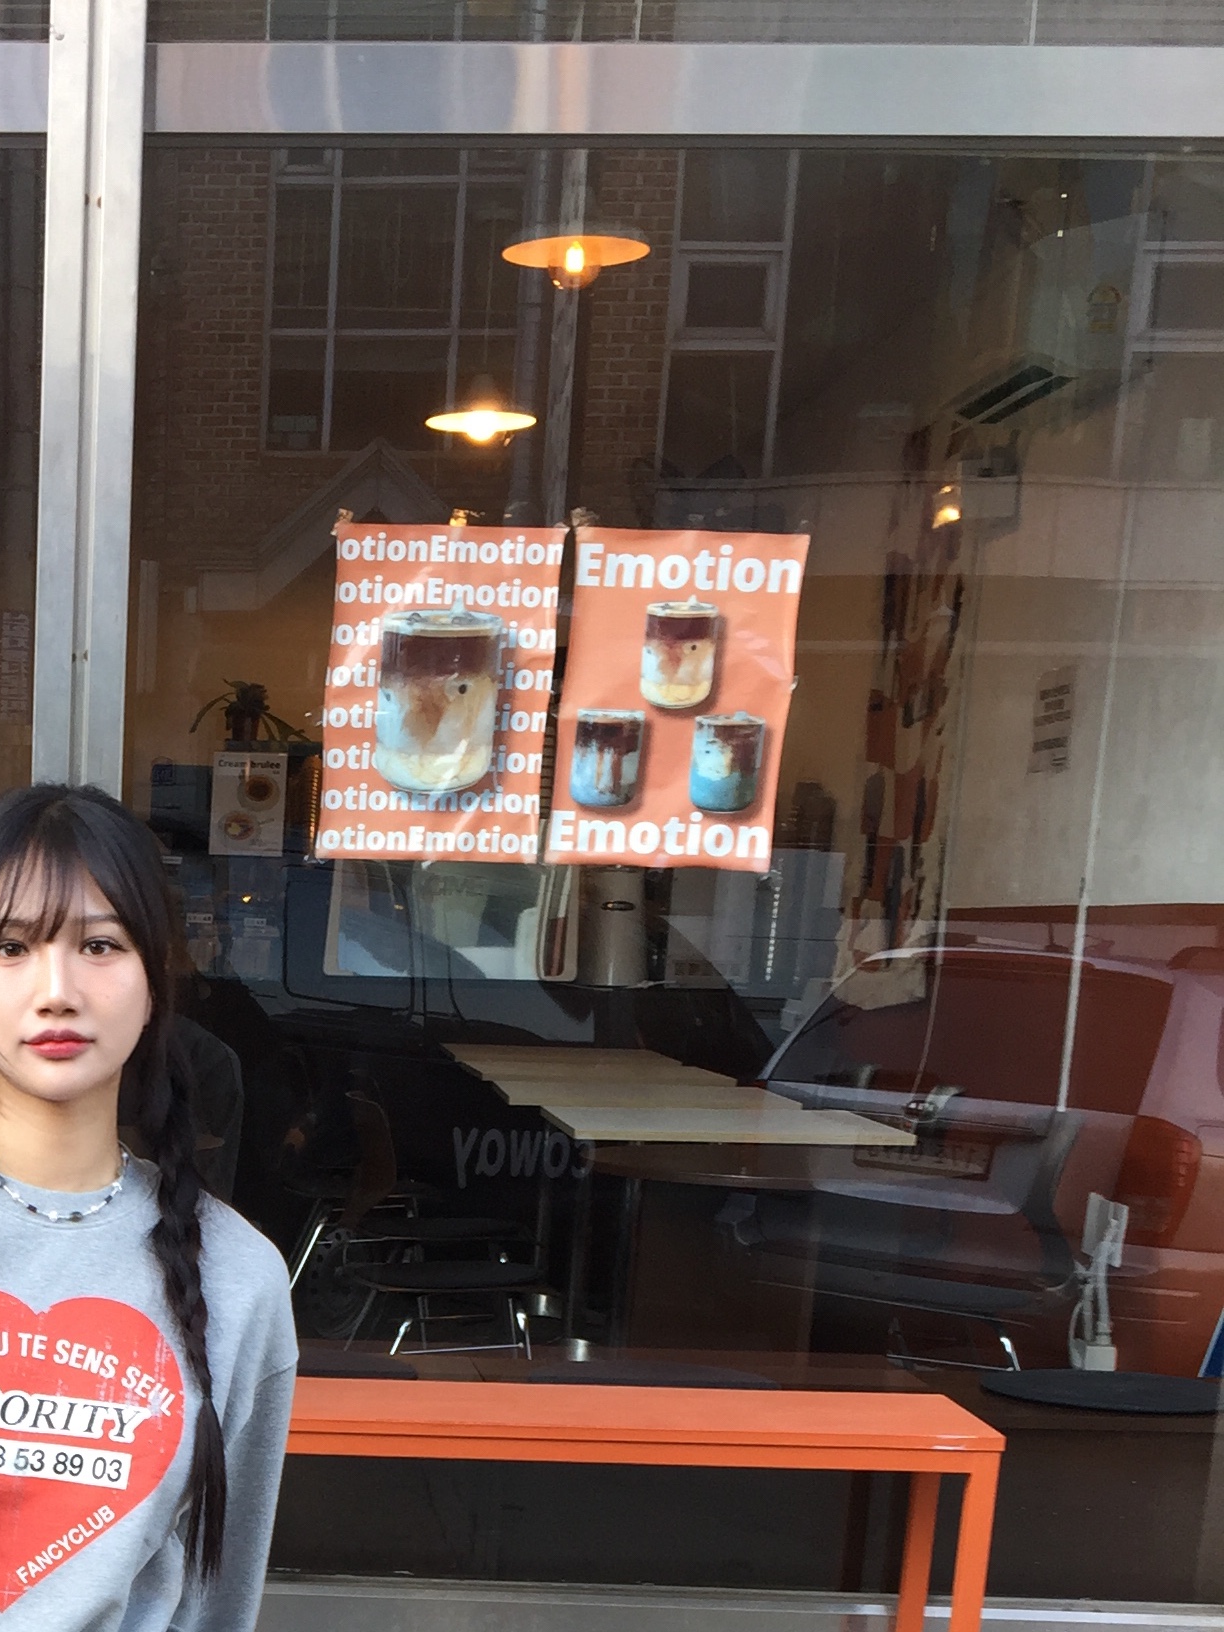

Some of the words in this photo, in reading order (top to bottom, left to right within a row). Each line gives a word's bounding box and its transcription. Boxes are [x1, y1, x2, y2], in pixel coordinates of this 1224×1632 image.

[576, 543, 801, 594] Emotion
[321, 783, 541, 815] otionEmotion
[550, 810, 772, 859] Emotion
[17, 1332, 47, 1360] TE
[53, 1339, 120, 1380] SENS
[121, 1367, 176, 1418] SEUL
[14, 1447, 45, 1473] 53
[53, 1452, 84, 1477] 89
[92, 1456, 123, 1483] 03
[16, 1504, 116, 1584] FANCYCLUB
